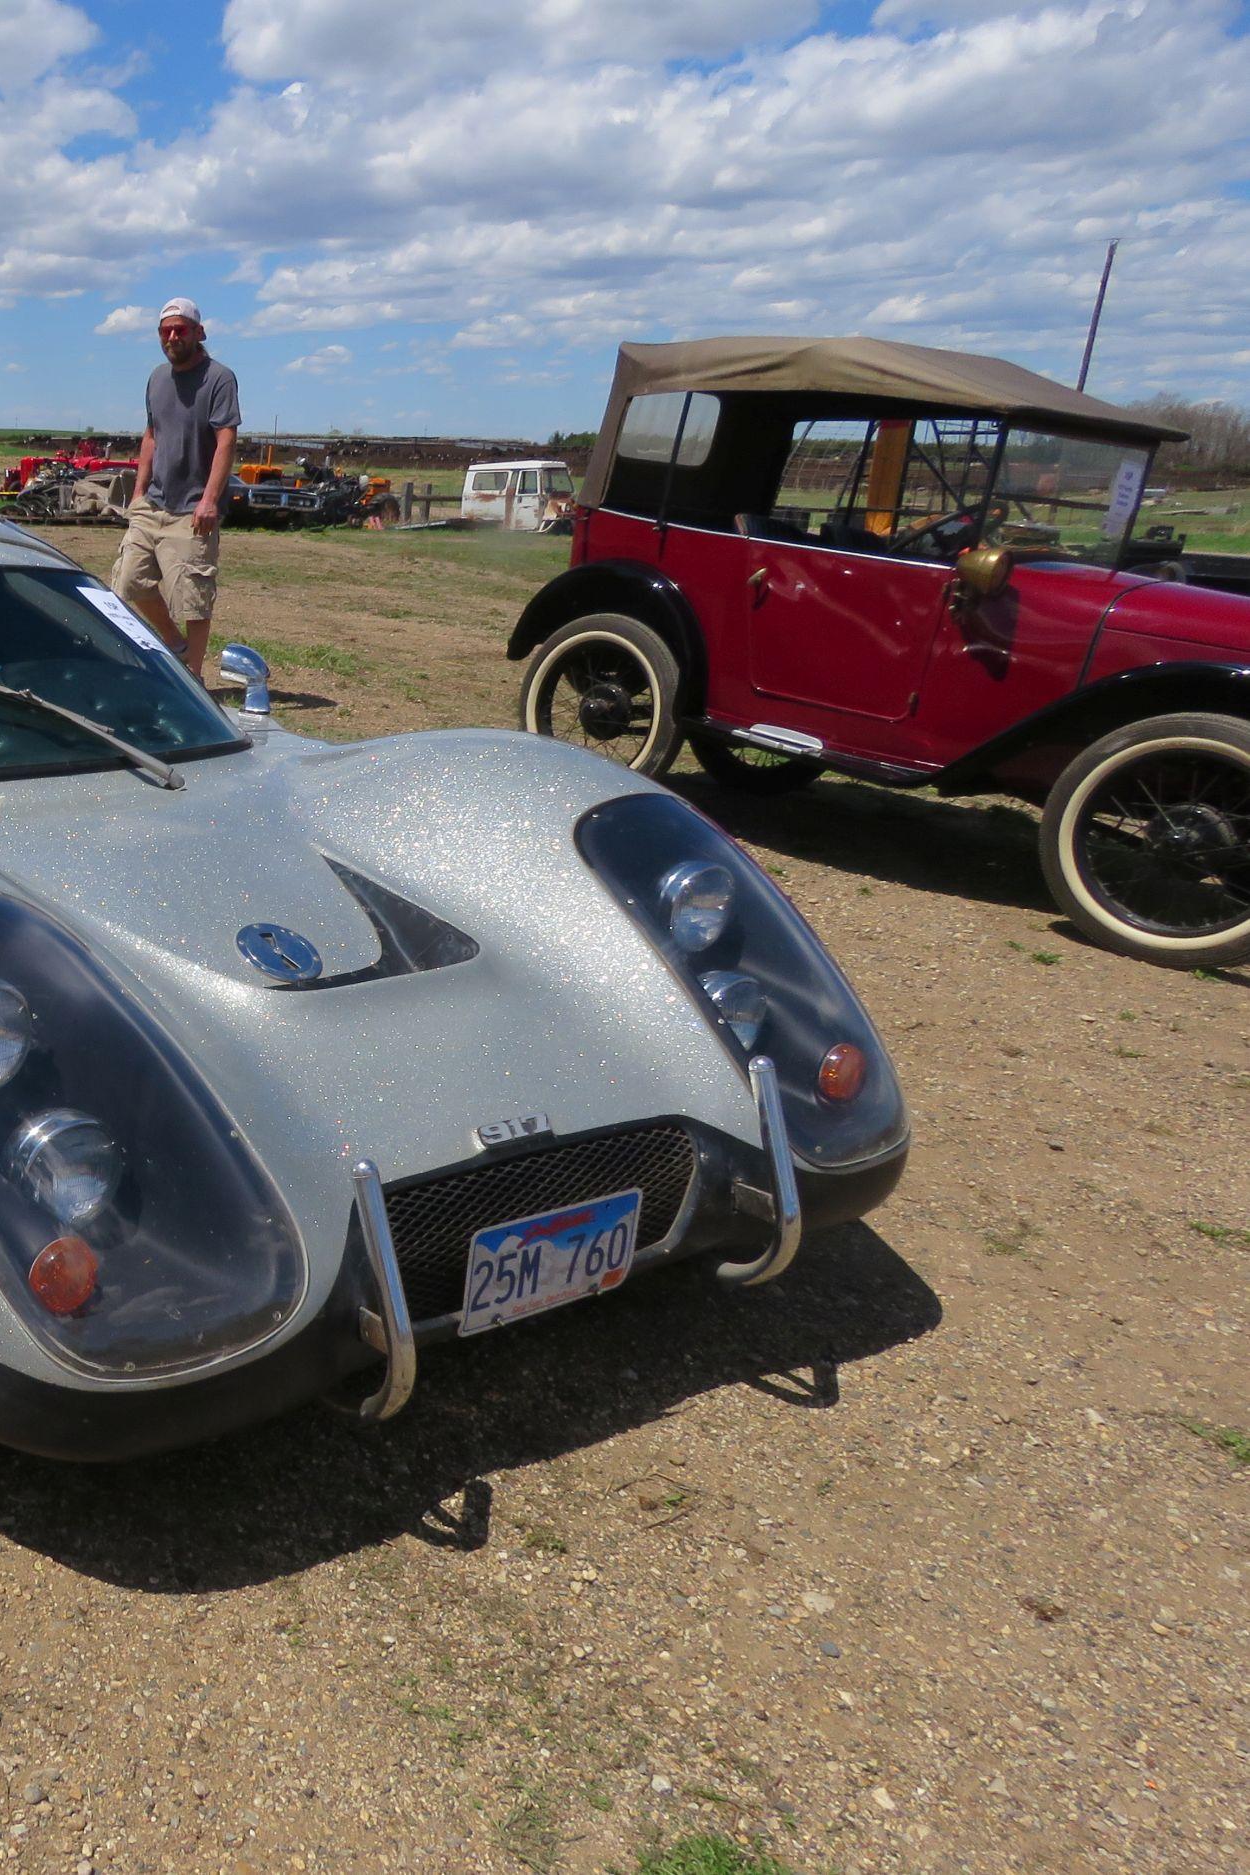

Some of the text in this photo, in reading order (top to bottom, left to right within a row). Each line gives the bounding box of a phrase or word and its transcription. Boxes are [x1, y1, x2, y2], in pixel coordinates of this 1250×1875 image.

[478, 1112, 550, 1145] 917
[470, 1246, 542, 1312] 25M
[566, 1222, 628, 1284] 760
